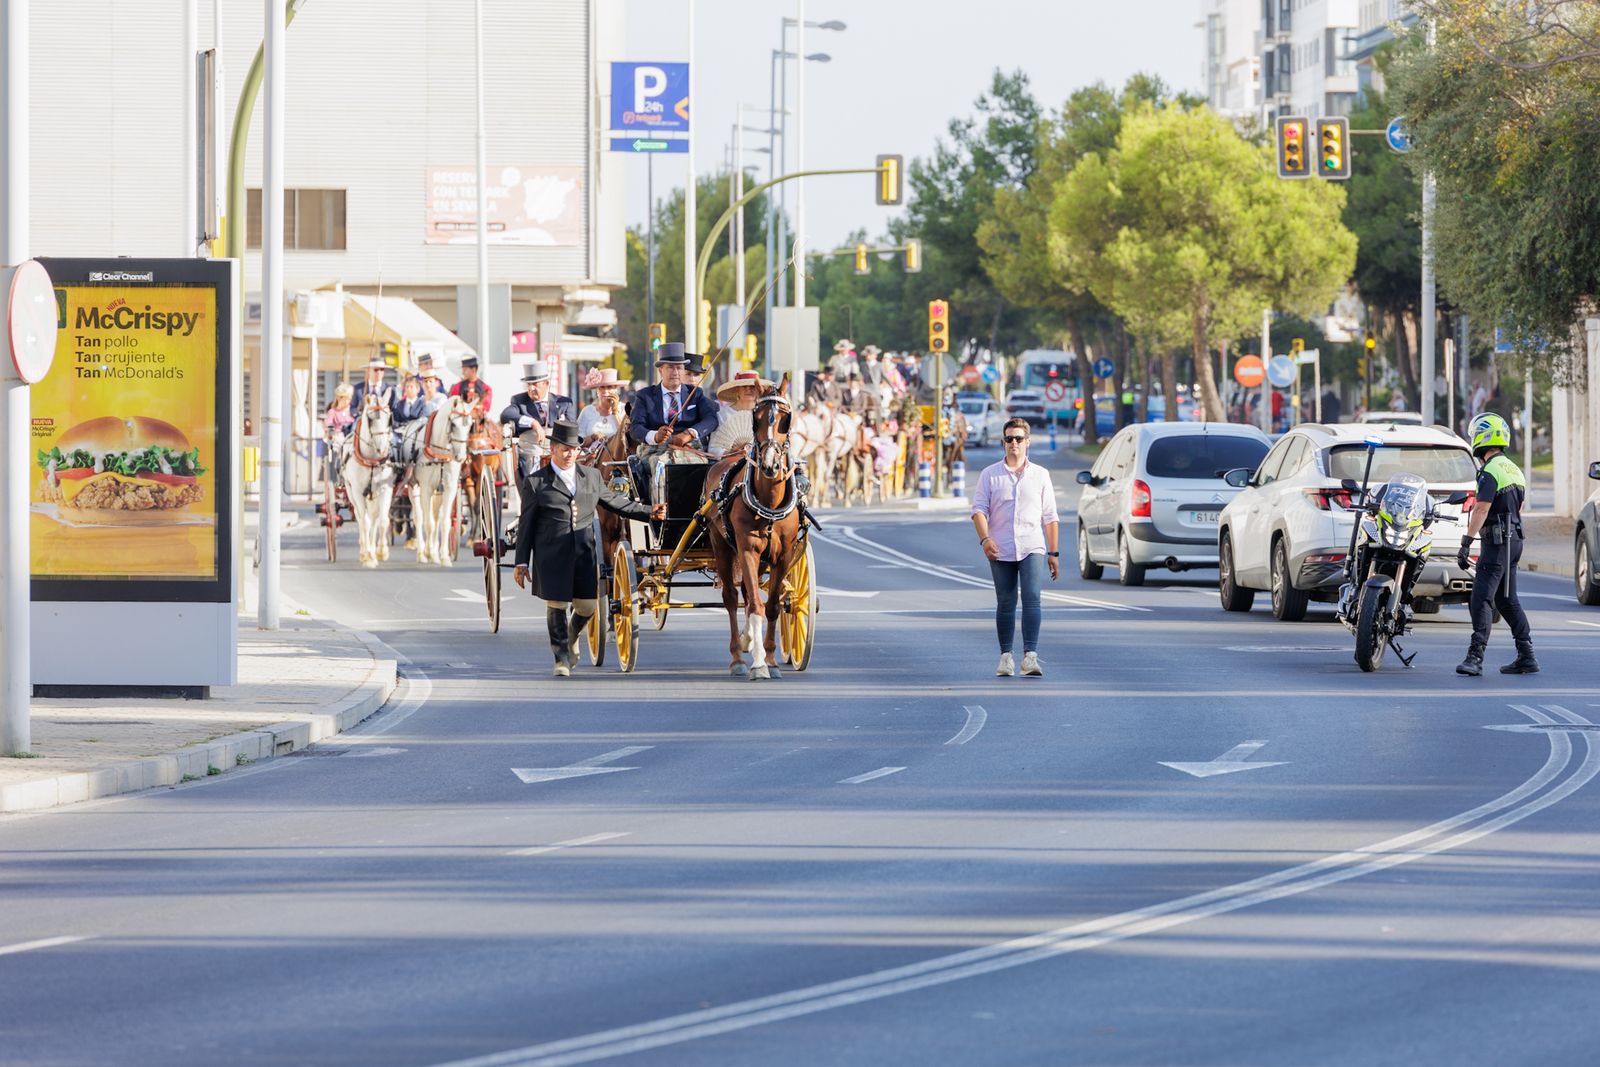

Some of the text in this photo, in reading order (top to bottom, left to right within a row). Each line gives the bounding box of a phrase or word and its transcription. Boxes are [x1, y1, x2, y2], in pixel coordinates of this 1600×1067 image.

[634, 66, 667, 113] P
[103, 273, 150, 281] Clear Channel
[106, 297, 127, 312] NUEVA
[75, 304, 199, 336] McCrispy
[75, 336, 138, 350] Tan pollo
[75, 351, 166, 366] Tan crujiente
[75, 367, 184, 379] Tan McDonald's
